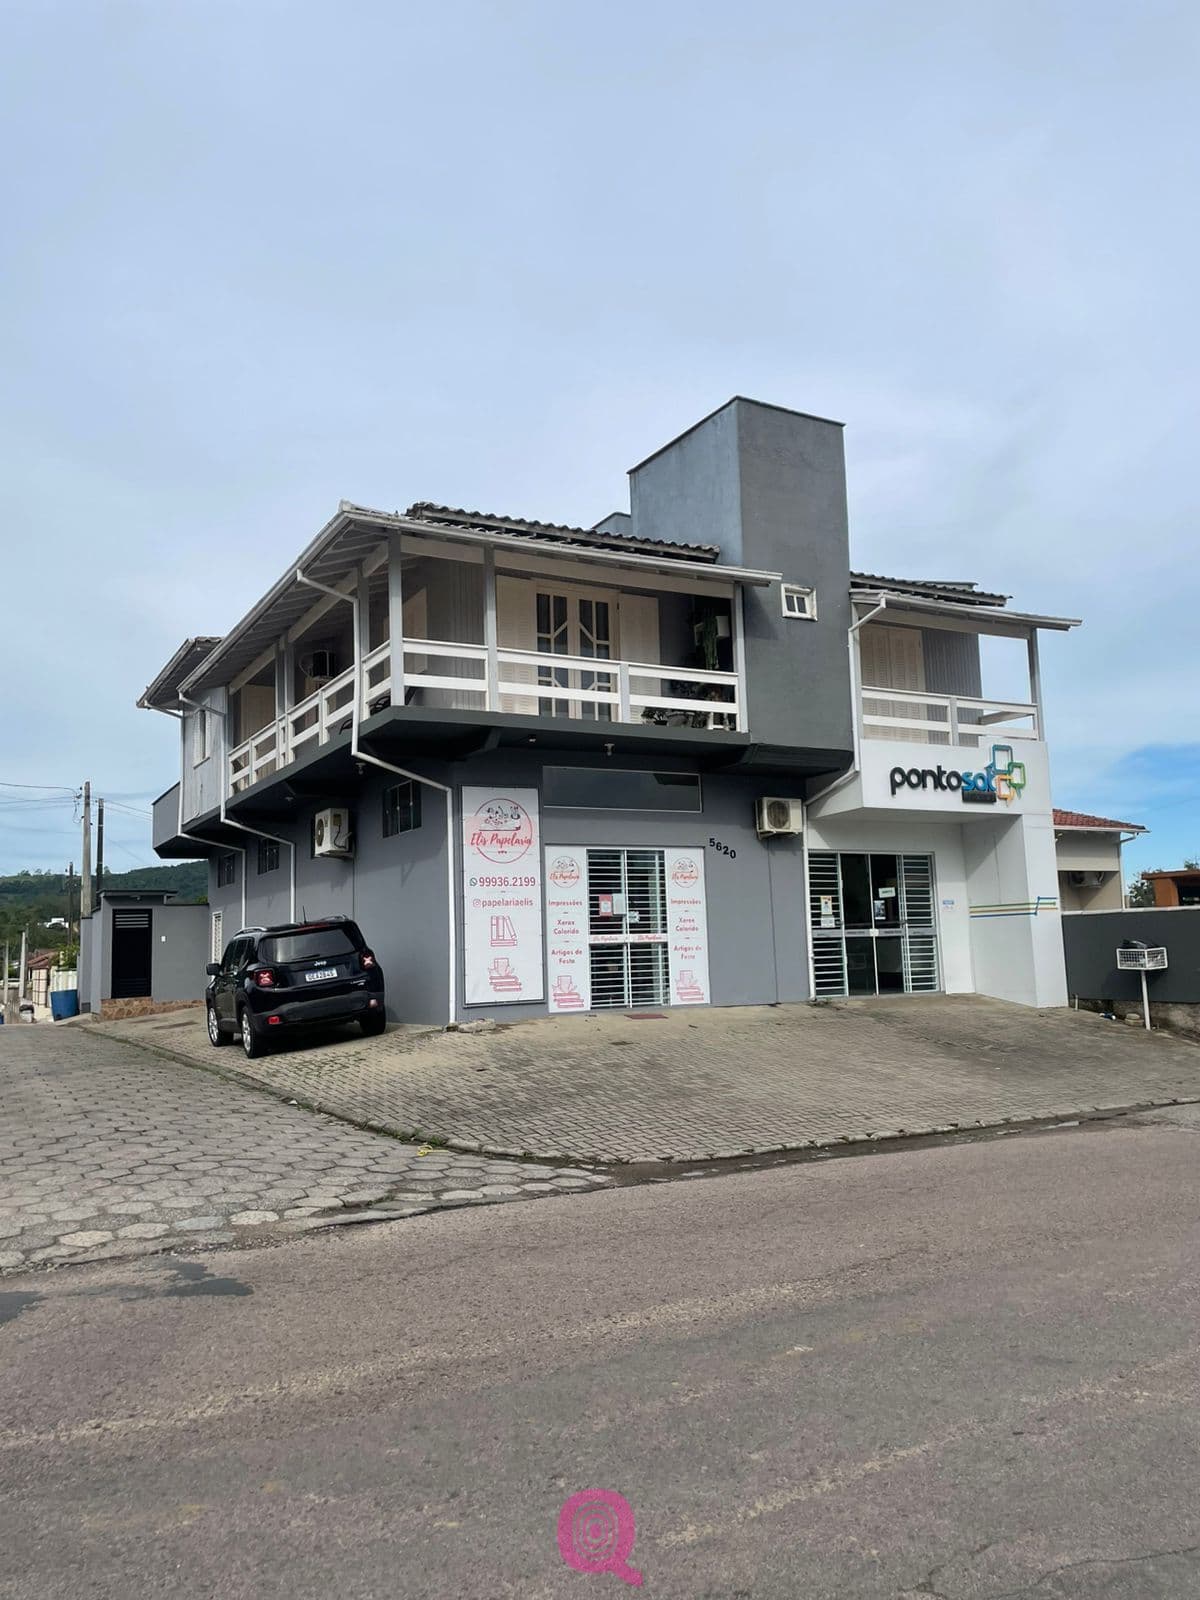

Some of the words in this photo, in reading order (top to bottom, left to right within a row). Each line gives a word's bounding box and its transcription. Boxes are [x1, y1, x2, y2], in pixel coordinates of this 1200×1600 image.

[489, 832, 532, 848] Papelaria
[709, 837, 736, 859] 5620
[478, 876, 536, 887] 99936.2199
[551, 948, 574, 957] Artigos
